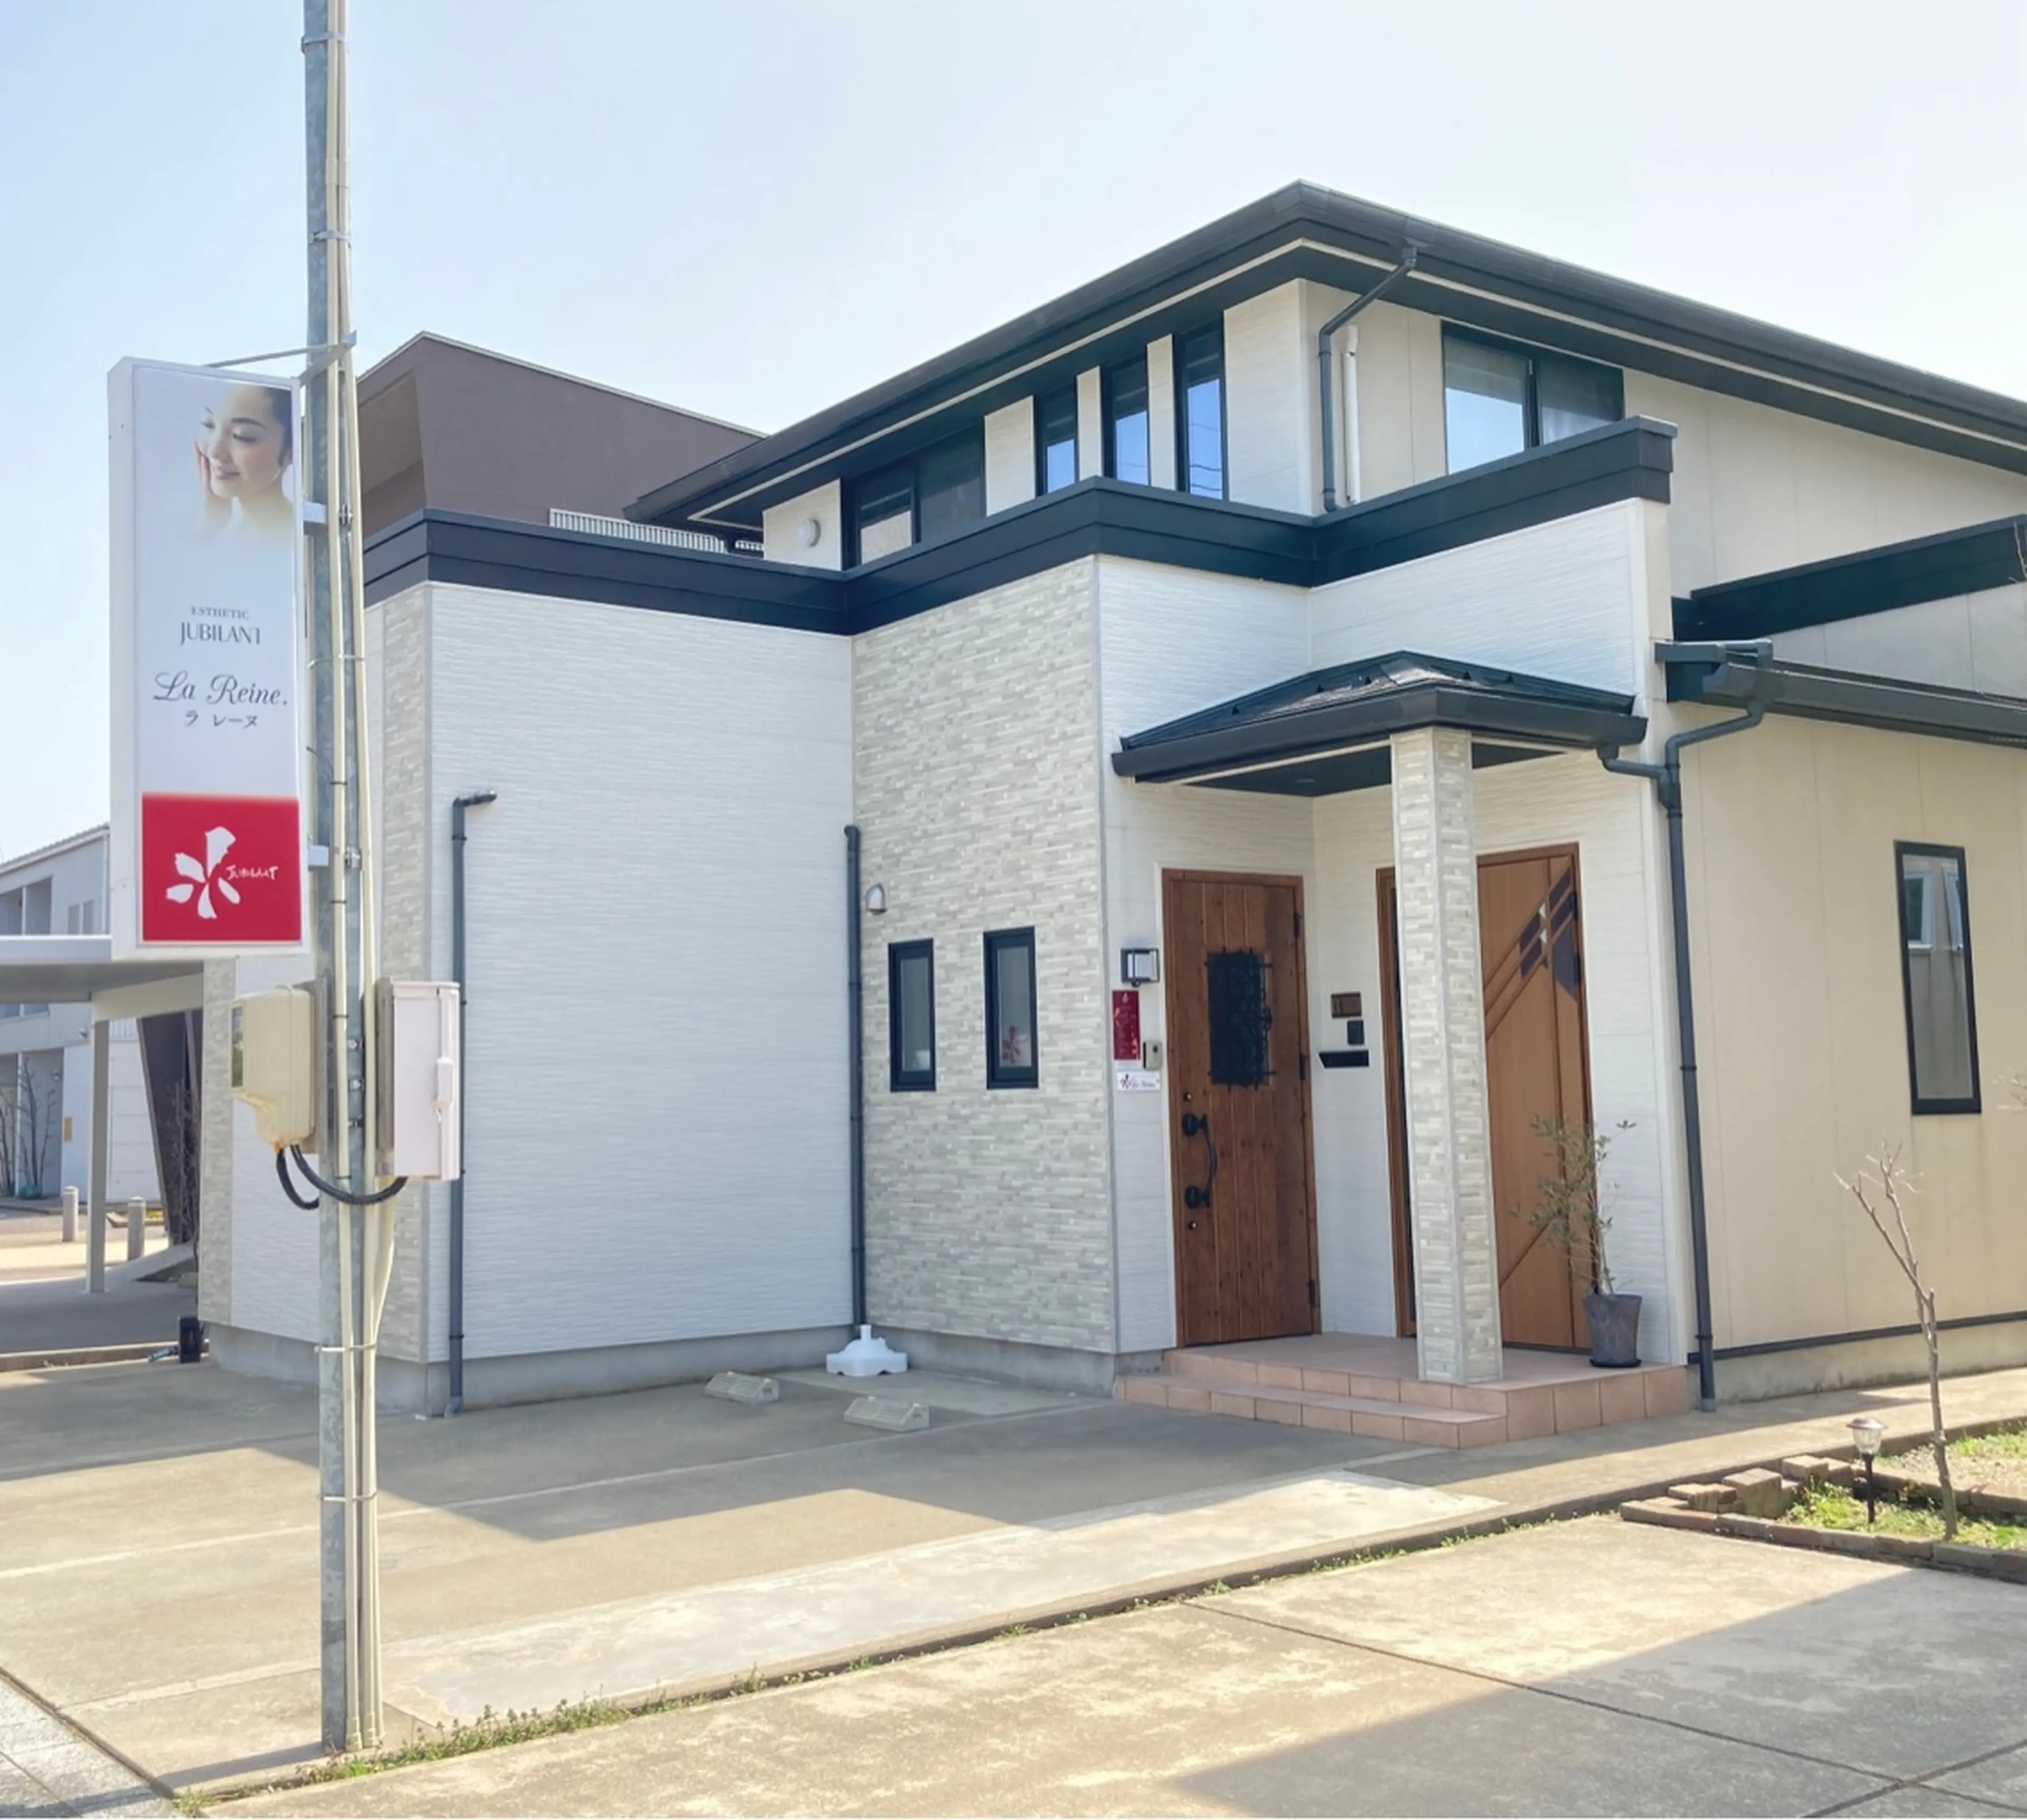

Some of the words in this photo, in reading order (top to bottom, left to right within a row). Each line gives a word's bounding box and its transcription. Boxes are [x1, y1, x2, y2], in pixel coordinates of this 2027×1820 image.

[191, 605, 249, 620] ESTHETIC
[153, 670, 196, 702] La
[186, 710, 199, 727] ラ
[213, 714, 258, 728] レーヌ
